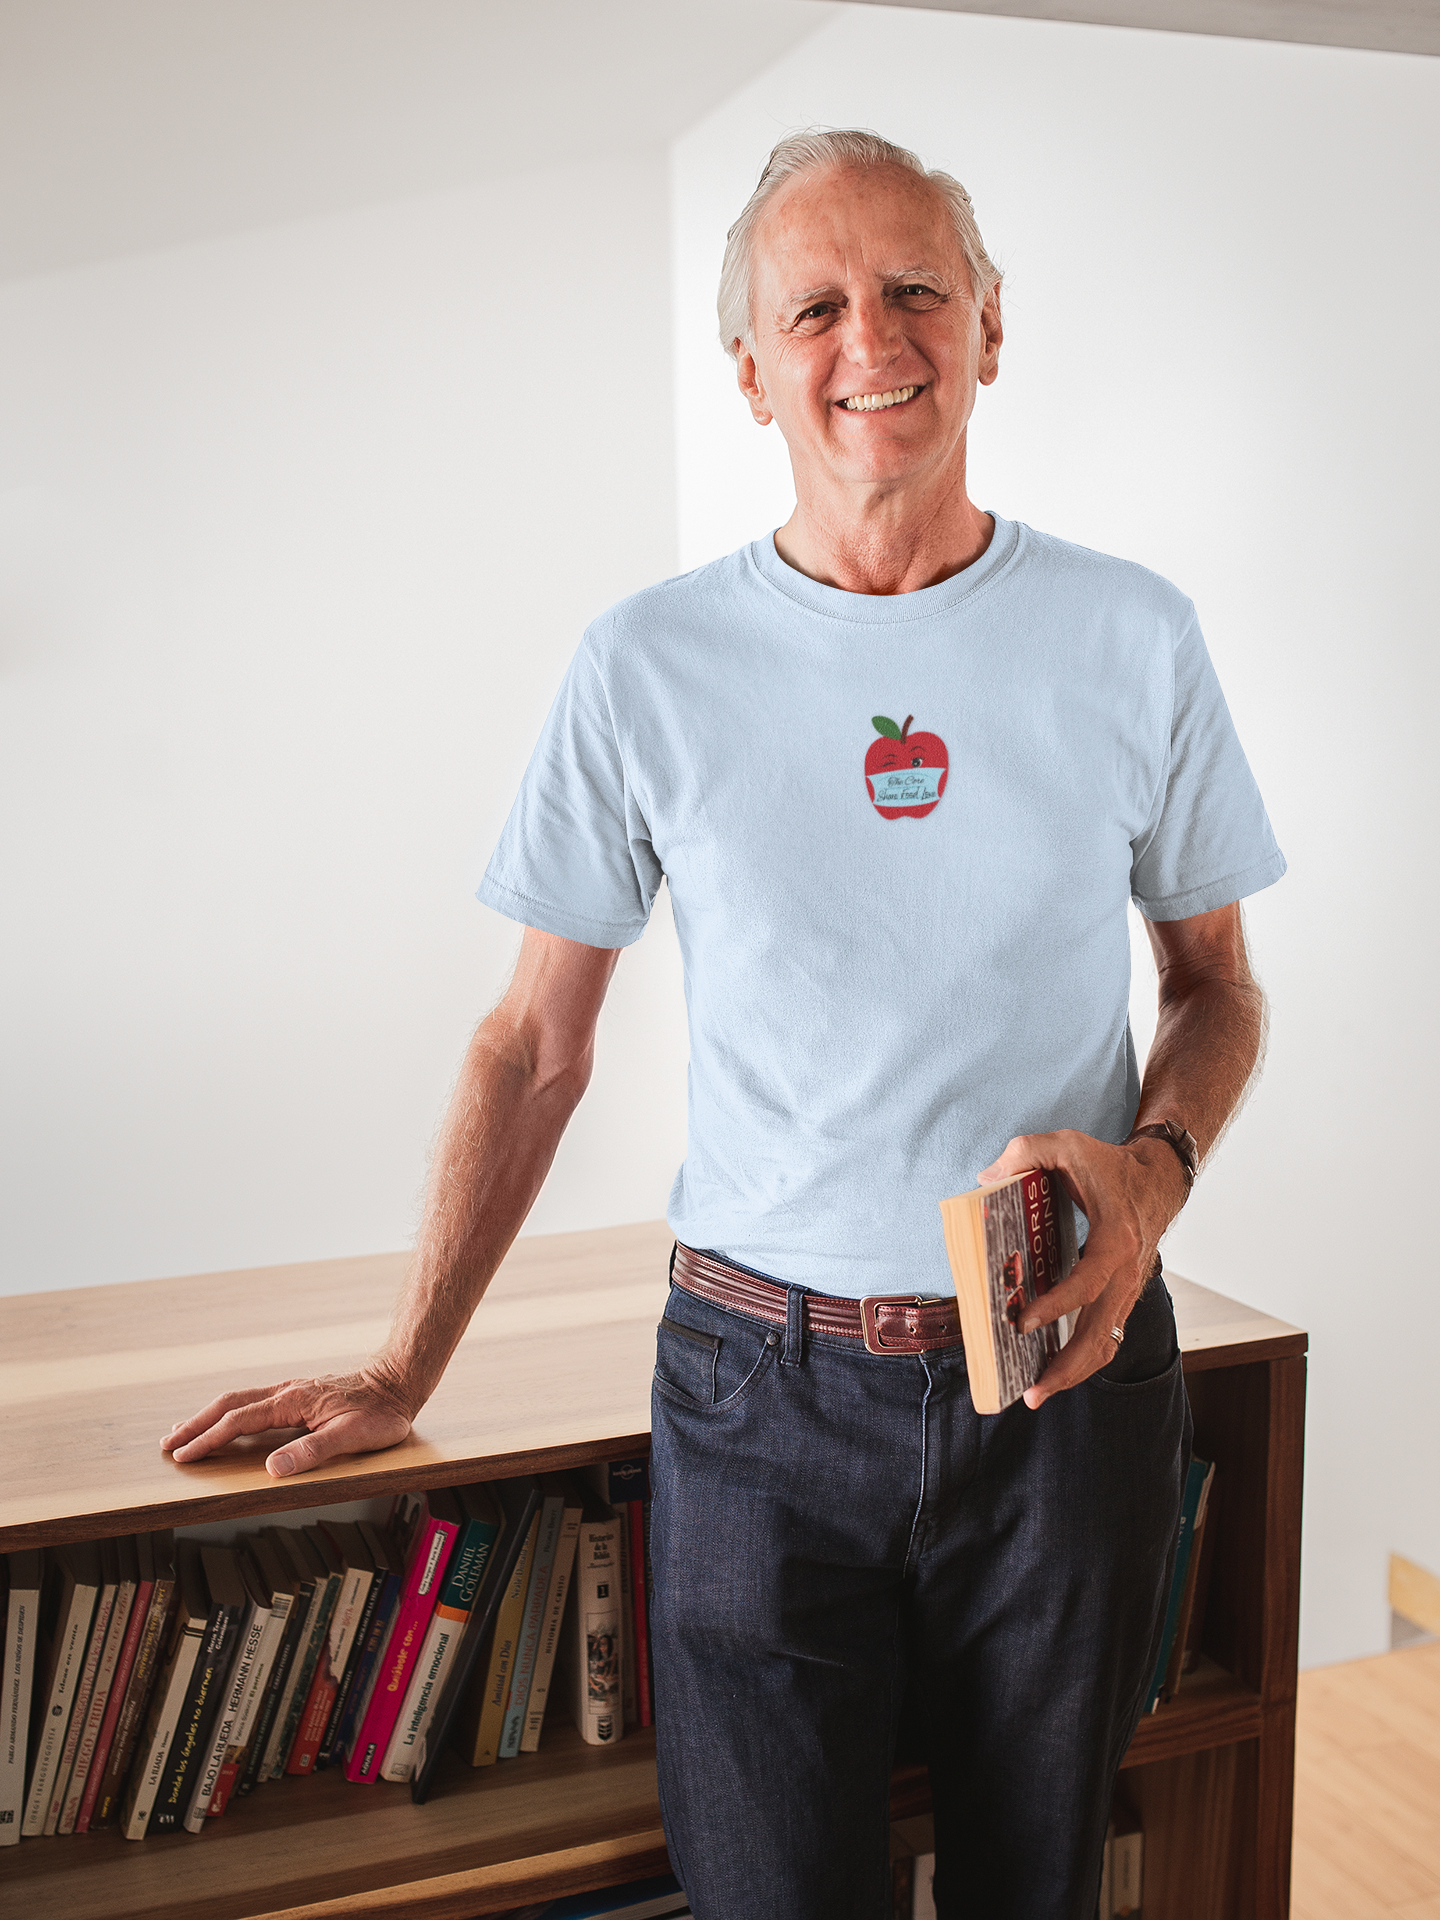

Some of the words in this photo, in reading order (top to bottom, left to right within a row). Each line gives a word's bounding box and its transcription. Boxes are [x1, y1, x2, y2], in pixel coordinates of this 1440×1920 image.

[877, 788, 898, 802] Share
[900, 787, 919, 800] Food
[921, 787, 937, 800] Love
[1028, 1181, 1045, 1278] DORIS
[1040, 1176, 1060, 1283] ESSING
[451, 1543, 477, 1587] DANIEL
[458, 1541, 491, 1603] GOLEMAN
[510, 1577, 522, 1599] Neale
[527, 1564, 548, 1629] PARPADEA
[554, 1574, 565, 1603] CRISTO
[17, 1605, 25, 1634] DESPIDEN
[212, 1609, 224, 1632] Teresa
[552, 1604, 560, 1615] DE
[16, 1635, 23, 1643] SE
[68, 1623, 79, 1650] venta
[498, 1639, 512, 1658] Dios
[544, 1618, 557, 1654] HISTORIA
[65, 1652, 72, 1665] en
[424, 1631, 451, 1680] emocional
[498, 1659, 508, 1673] con
[519, 1631, 536, 1674] NUNCA
[57, 1667, 69, 1693] Ideas
[227, 1660, 251, 1712] HERMANN
[243, 1623, 263, 1660] HESSE
[251, 1662, 265, 1690] perfume
[194, 1665, 214, 1705] duermen
[248, 1689, 256, 1697] El
[490, 1673, 506, 1706] Amistad
[513, 1676, 528, 1706] DIOS
[192, 1707, 202, 1720] no
[406, 1680, 435, 1733] inteligencia
[9, 1714, 17, 1744] ARMANDO
[75, 1737, 94, 1779] DIEGO
[88, 1688, 107, 1728] FRIDA
[214, 1718, 233, 1753] RUEDA
[402, 1732, 415, 1746] La
[7, 1744, 15, 1764] PABLO
[151, 1749, 164, 1775] ILIADA
[174, 1758, 188, 1774] los
[209, 1752, 222, 1768] LA
[148, 1774, 157, 1785] LA
[165, 1773, 183, 1804] Donde
[200, 1768, 217, 1797] BAJO
